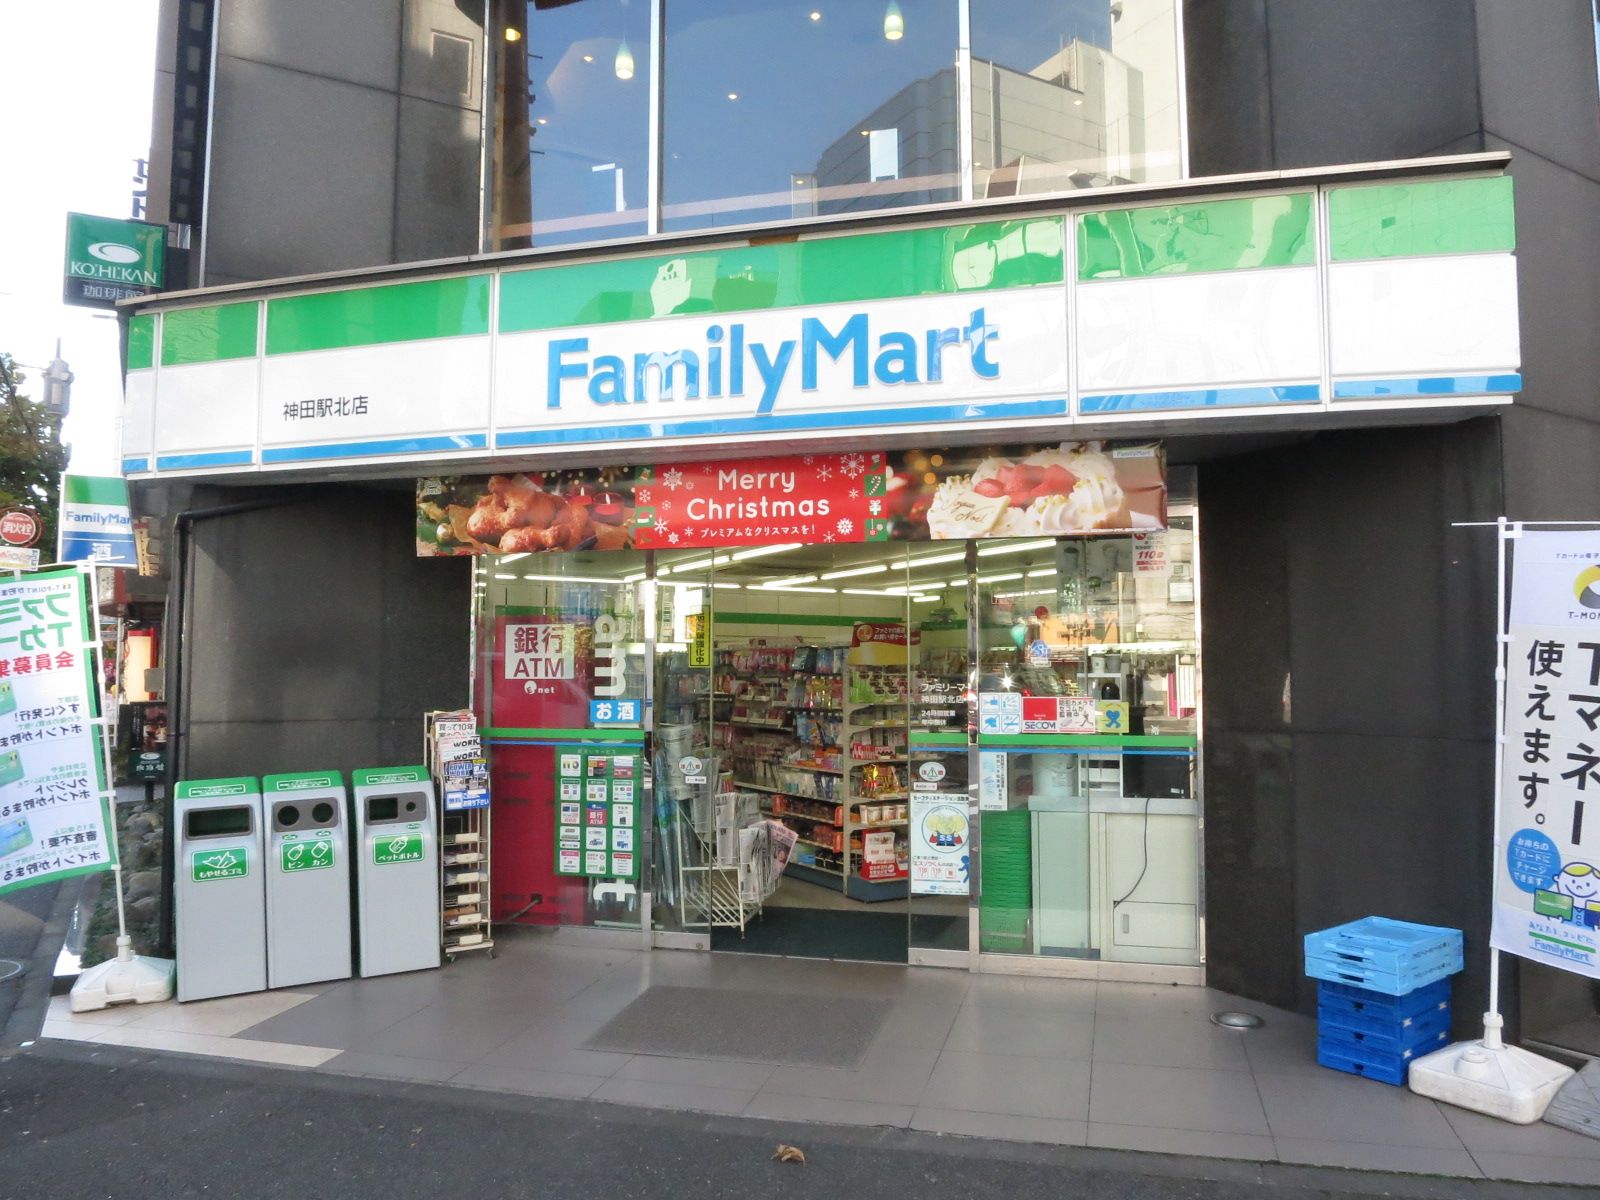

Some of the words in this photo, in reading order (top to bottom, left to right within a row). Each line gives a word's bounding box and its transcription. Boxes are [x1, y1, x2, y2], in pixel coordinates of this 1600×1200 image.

[547, 306, 1001, 416] FamilyMart
[283, 395, 369, 421] 神田駅北店
[718, 469, 796, 494] Merry
[66, 511, 130, 525] FamilyMar
[687, 498, 831, 521] Christmas
[1568, 611, 1600, 620] T-MO
[514, 627, 566, 654] 銀行
[513, 658, 565, 678] ATM
[921, 683, 970, 692] ファミリーマー
[596, 703, 635, 721] お酒
[1024, 721, 1056, 729] SECOM
[1517, 639, 1565, 825] 使えます。
[1534, 939, 1590, 962] FamilyMart
